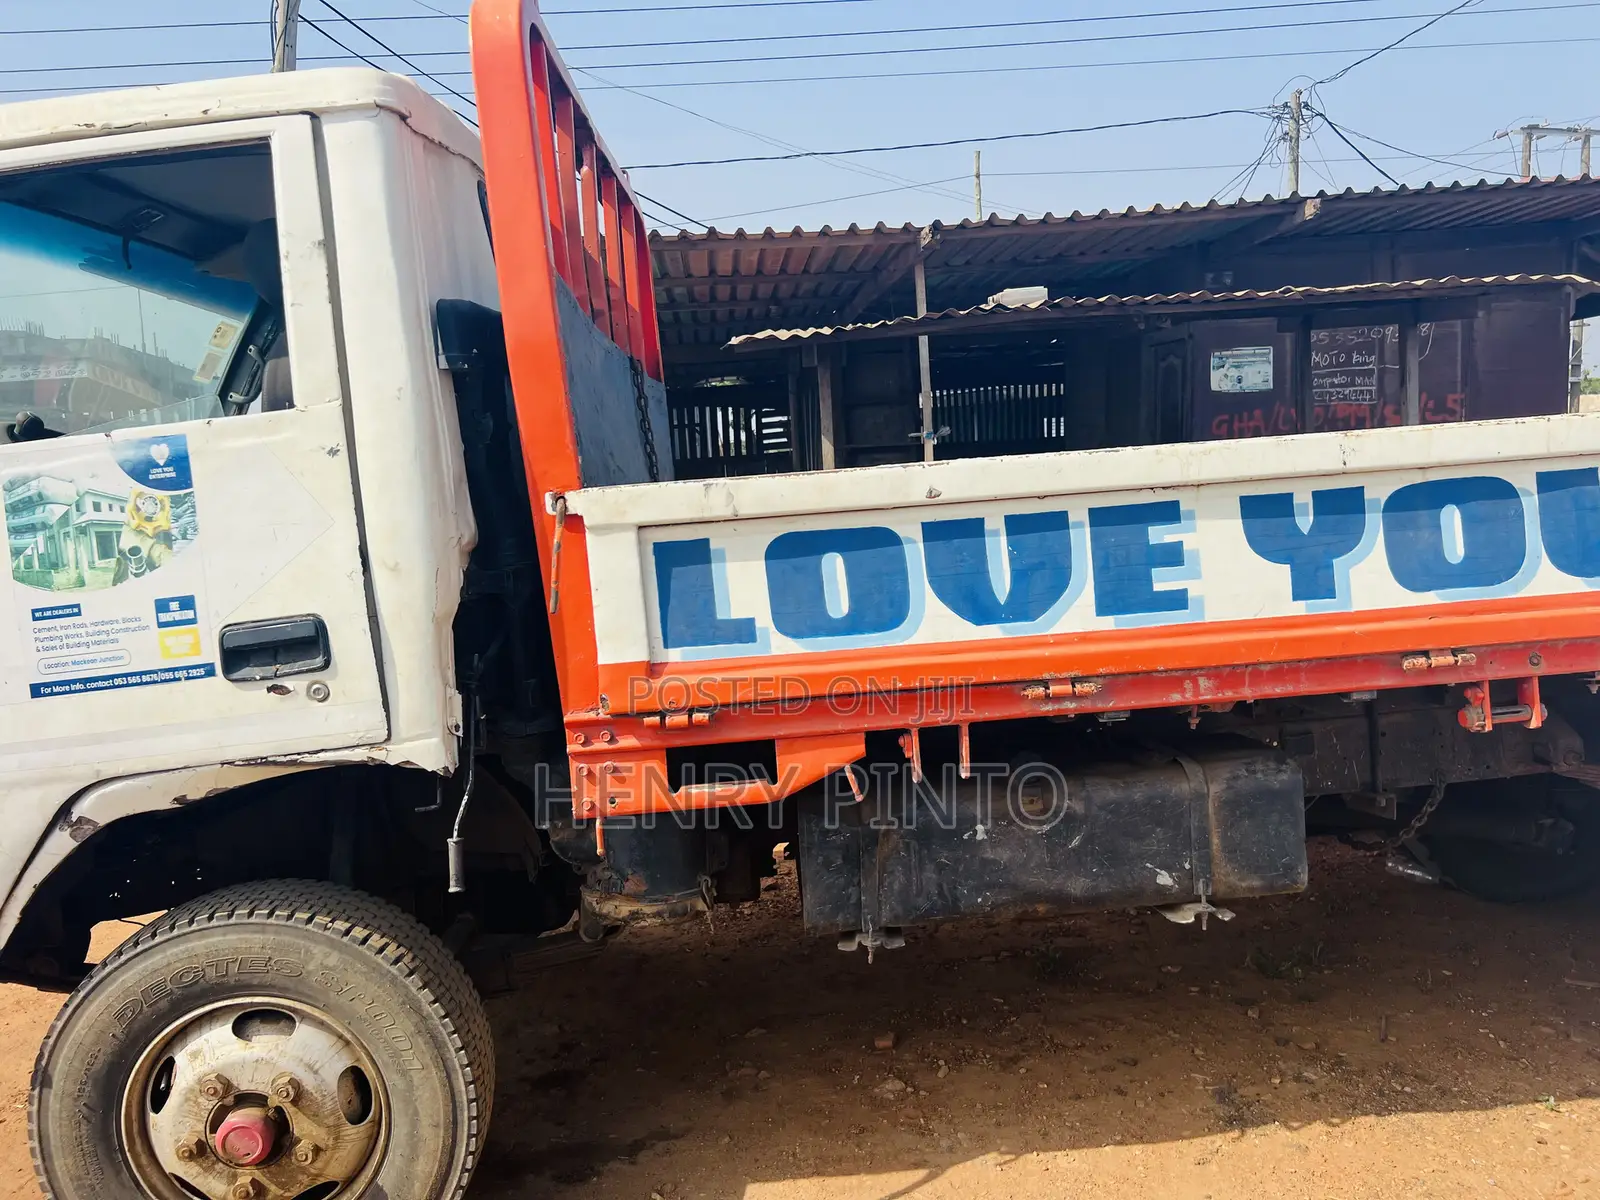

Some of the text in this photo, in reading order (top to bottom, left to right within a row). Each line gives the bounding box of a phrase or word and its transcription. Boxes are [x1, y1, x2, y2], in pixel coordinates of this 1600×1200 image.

[653, 500, 1203, 656] LOVE
[52, 608, 72, 616] DEALERS
[32, 625, 59, 634] Cement,
[72, 622, 88, 630] Rods,
[34, 624, 150, 644] Plumbing Works, Building Construction
[41, 644, 58, 652] Sales
[66, 640, 90, 650] Building
[91, 637, 119, 646] Materials
[40, 686, 52, 694] For
[52, 684, 70, 693] More
[86, 679, 113, 689] contact
[113, 678, 127, 686] 053
[112, 955, 303, 1031] DECTES
